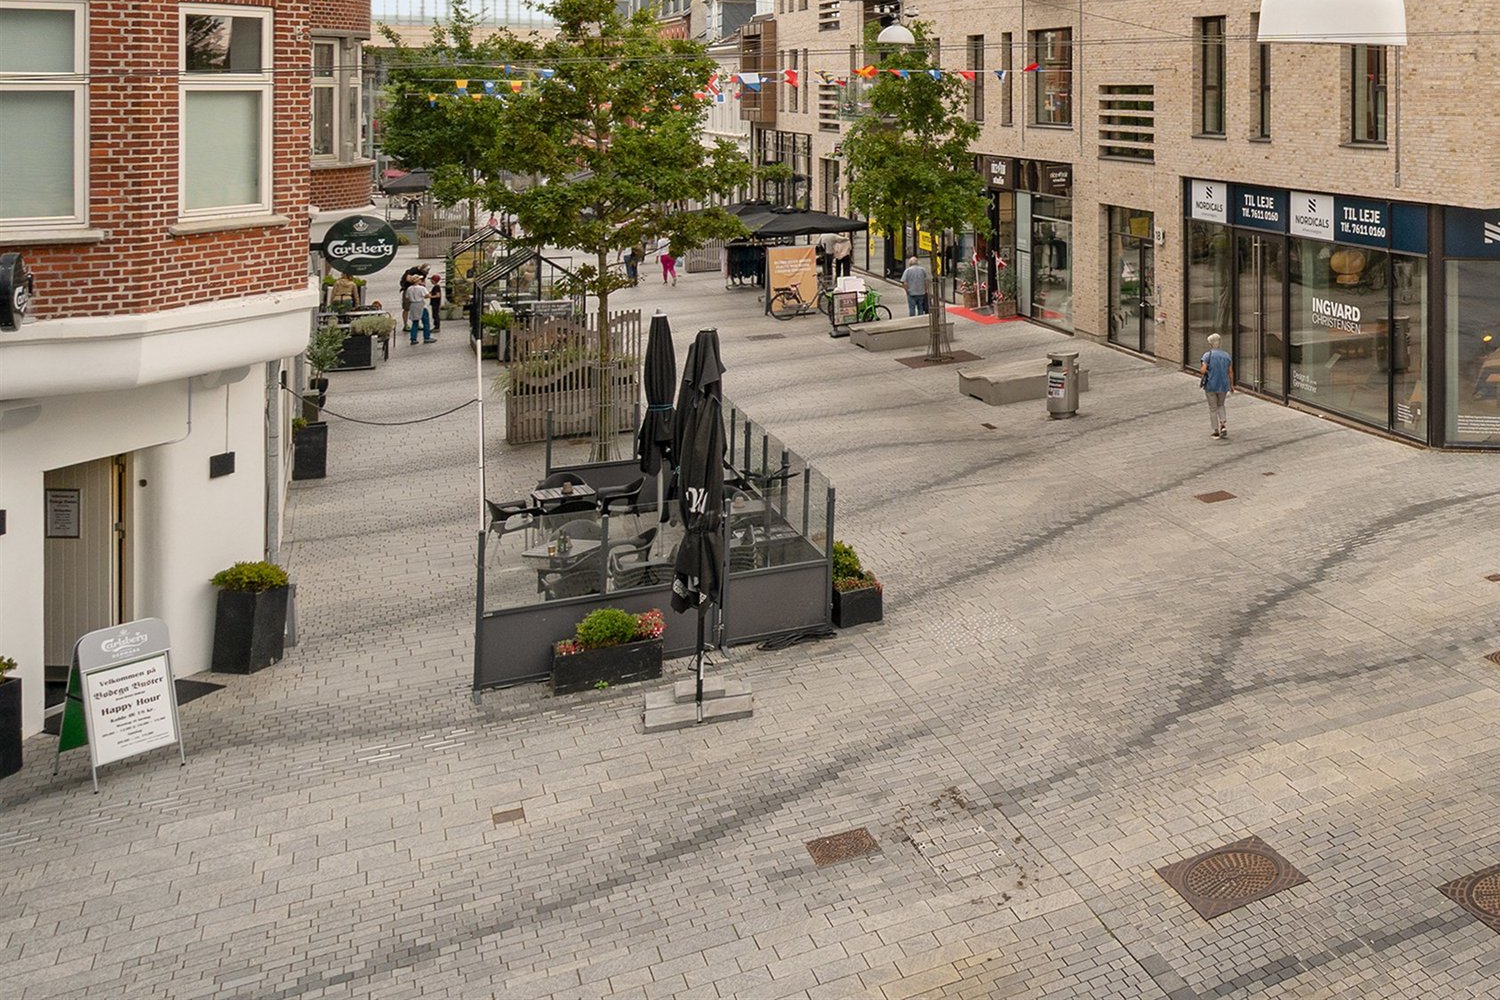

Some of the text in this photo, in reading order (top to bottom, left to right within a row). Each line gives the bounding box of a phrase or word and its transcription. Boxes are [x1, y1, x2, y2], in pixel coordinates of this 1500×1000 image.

[1195, 201, 1223, 213] NORDICALS
[1244, 194, 1274, 209] TIL LEJE
[1295, 214, 1329, 229] NORDICALS
[1343, 206, 1380, 224] TIL LEJE
[1352, 223, 1368, 236] 7611
[1368, 225, 1386, 238] 0160
[327, 239, 394, 262] Carlsberg
[1312, 297, 1360, 322] INGVARD
[1311, 313, 1361, 334] CHRISTENSEN
[101, 632, 148, 652] Carlsberg
[101, 702, 132, 716] Happy
[136, 694, 161, 706] Hour
